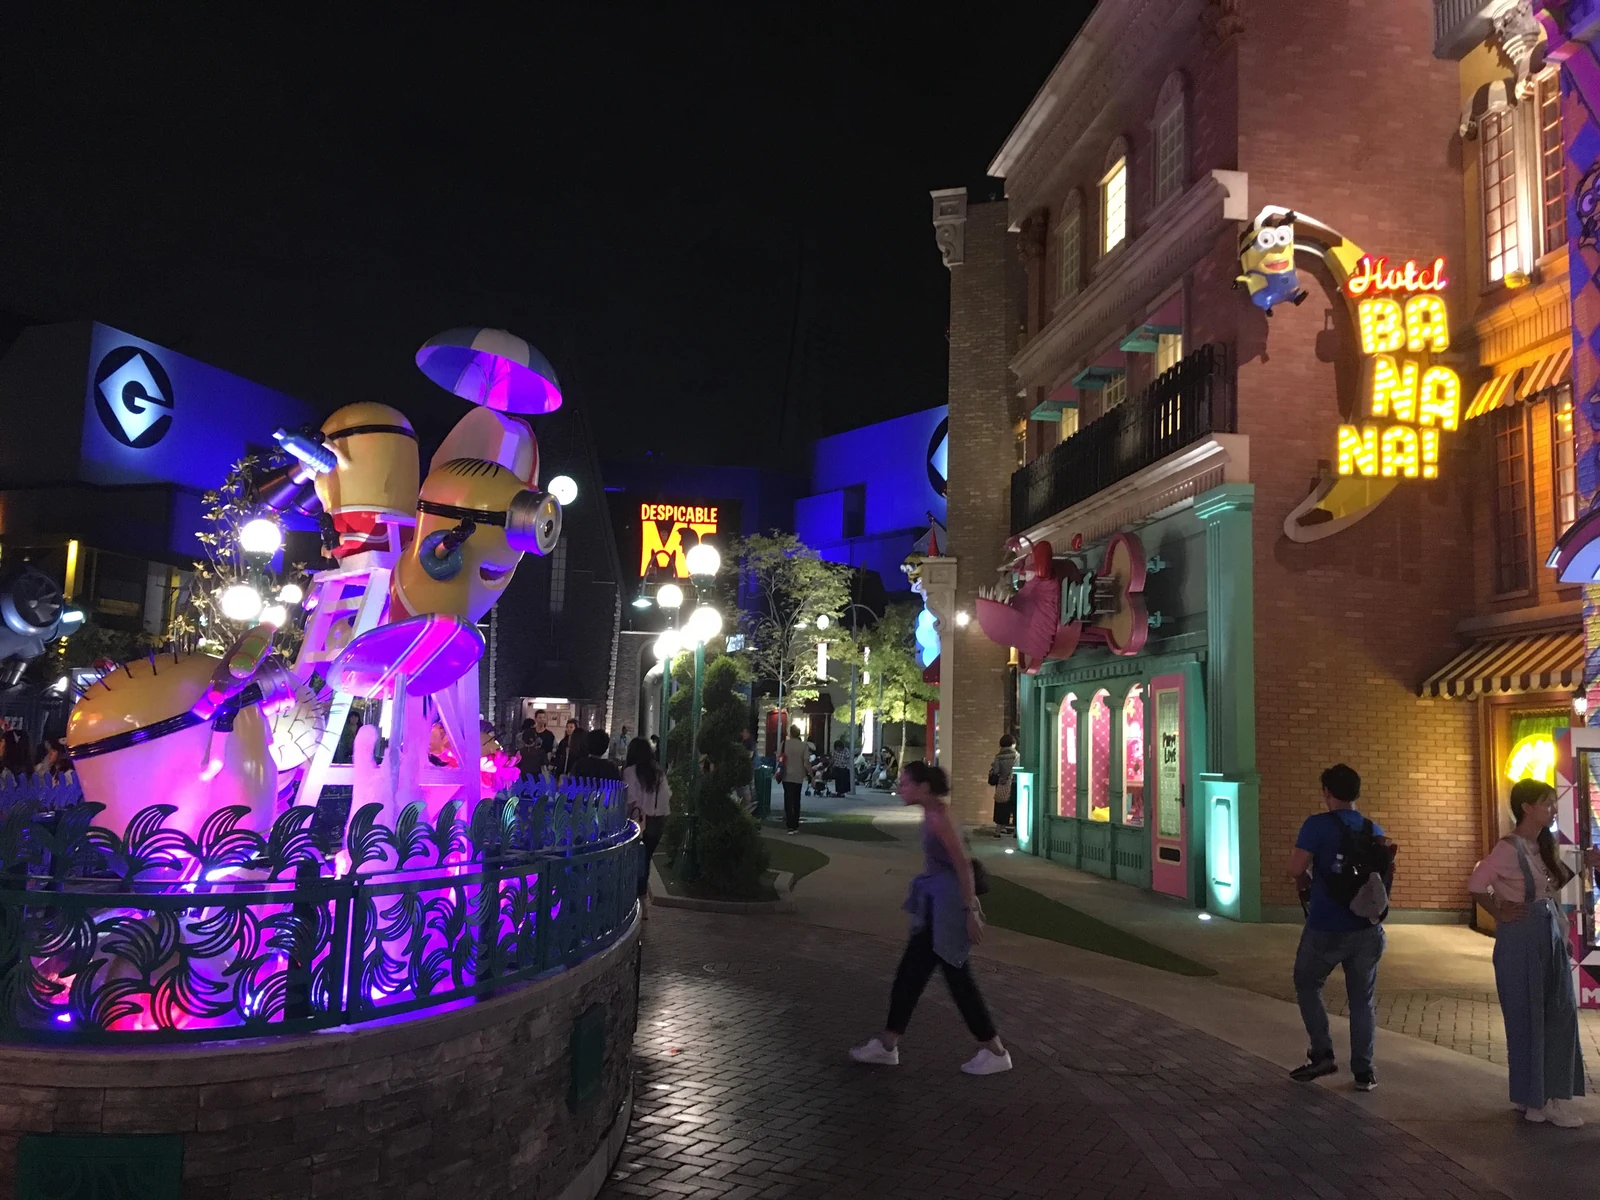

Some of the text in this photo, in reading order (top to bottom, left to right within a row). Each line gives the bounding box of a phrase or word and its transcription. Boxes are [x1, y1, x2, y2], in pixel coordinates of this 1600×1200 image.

[1346, 254, 1448, 295] Hotel
[1358, 294, 1450, 354] BA
[1371, 354, 1461, 431] NA
[1337, 424, 1440, 478] NA!
[640, 503, 719, 523] DESPICABLE
